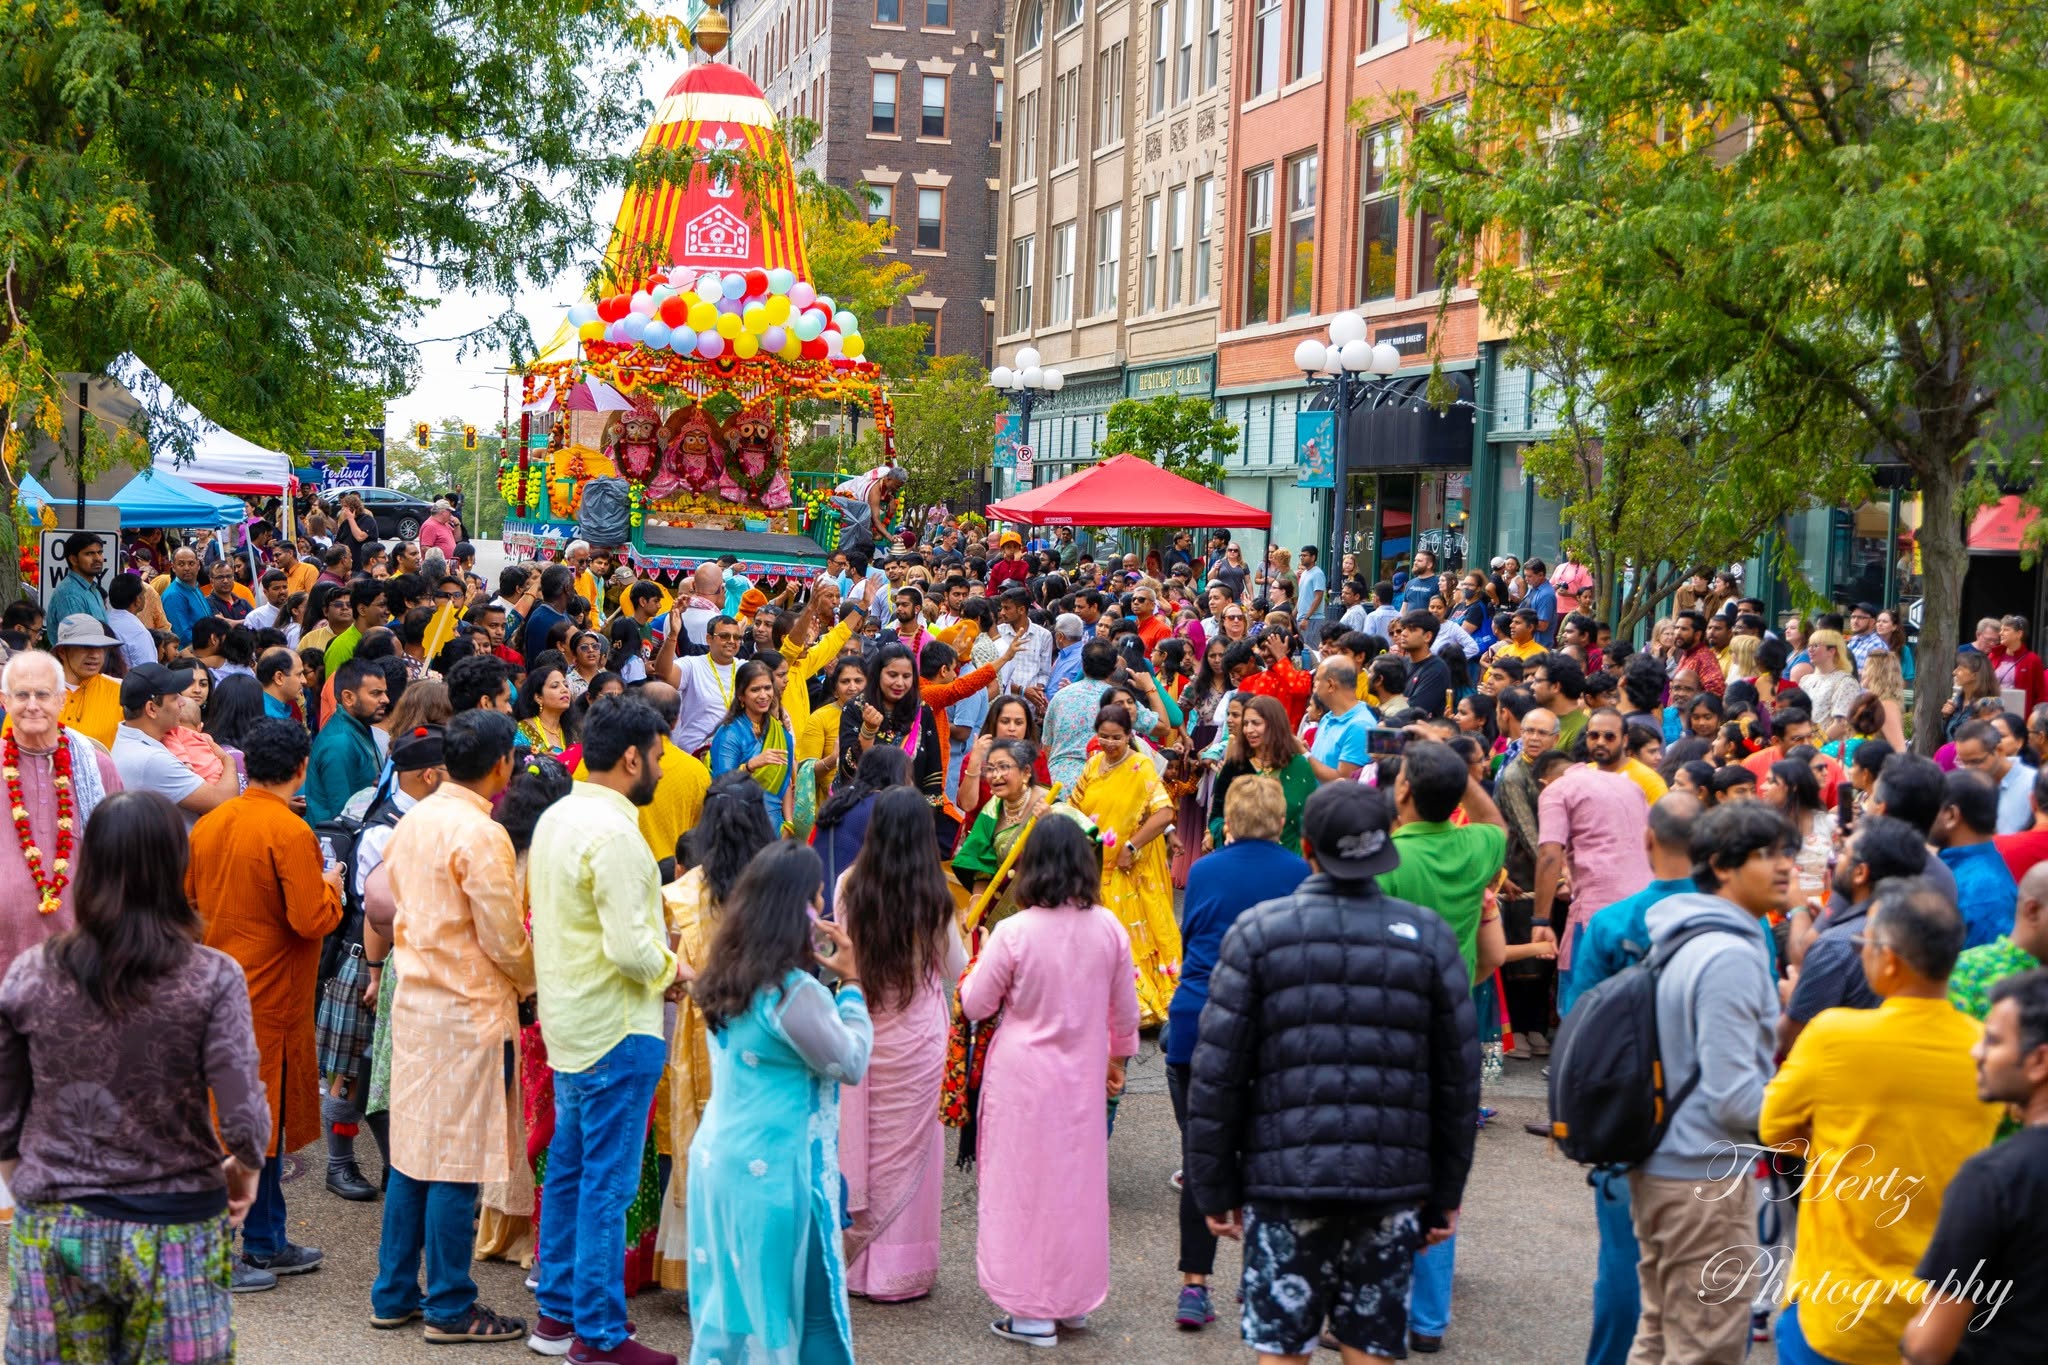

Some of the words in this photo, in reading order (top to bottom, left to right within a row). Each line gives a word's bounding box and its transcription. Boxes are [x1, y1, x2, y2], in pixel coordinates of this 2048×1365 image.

[1139, 370, 1172, 391] HERITAGE
[1176, 366, 1201, 386] PLAZA
[49, 566, 109, 588] WY
